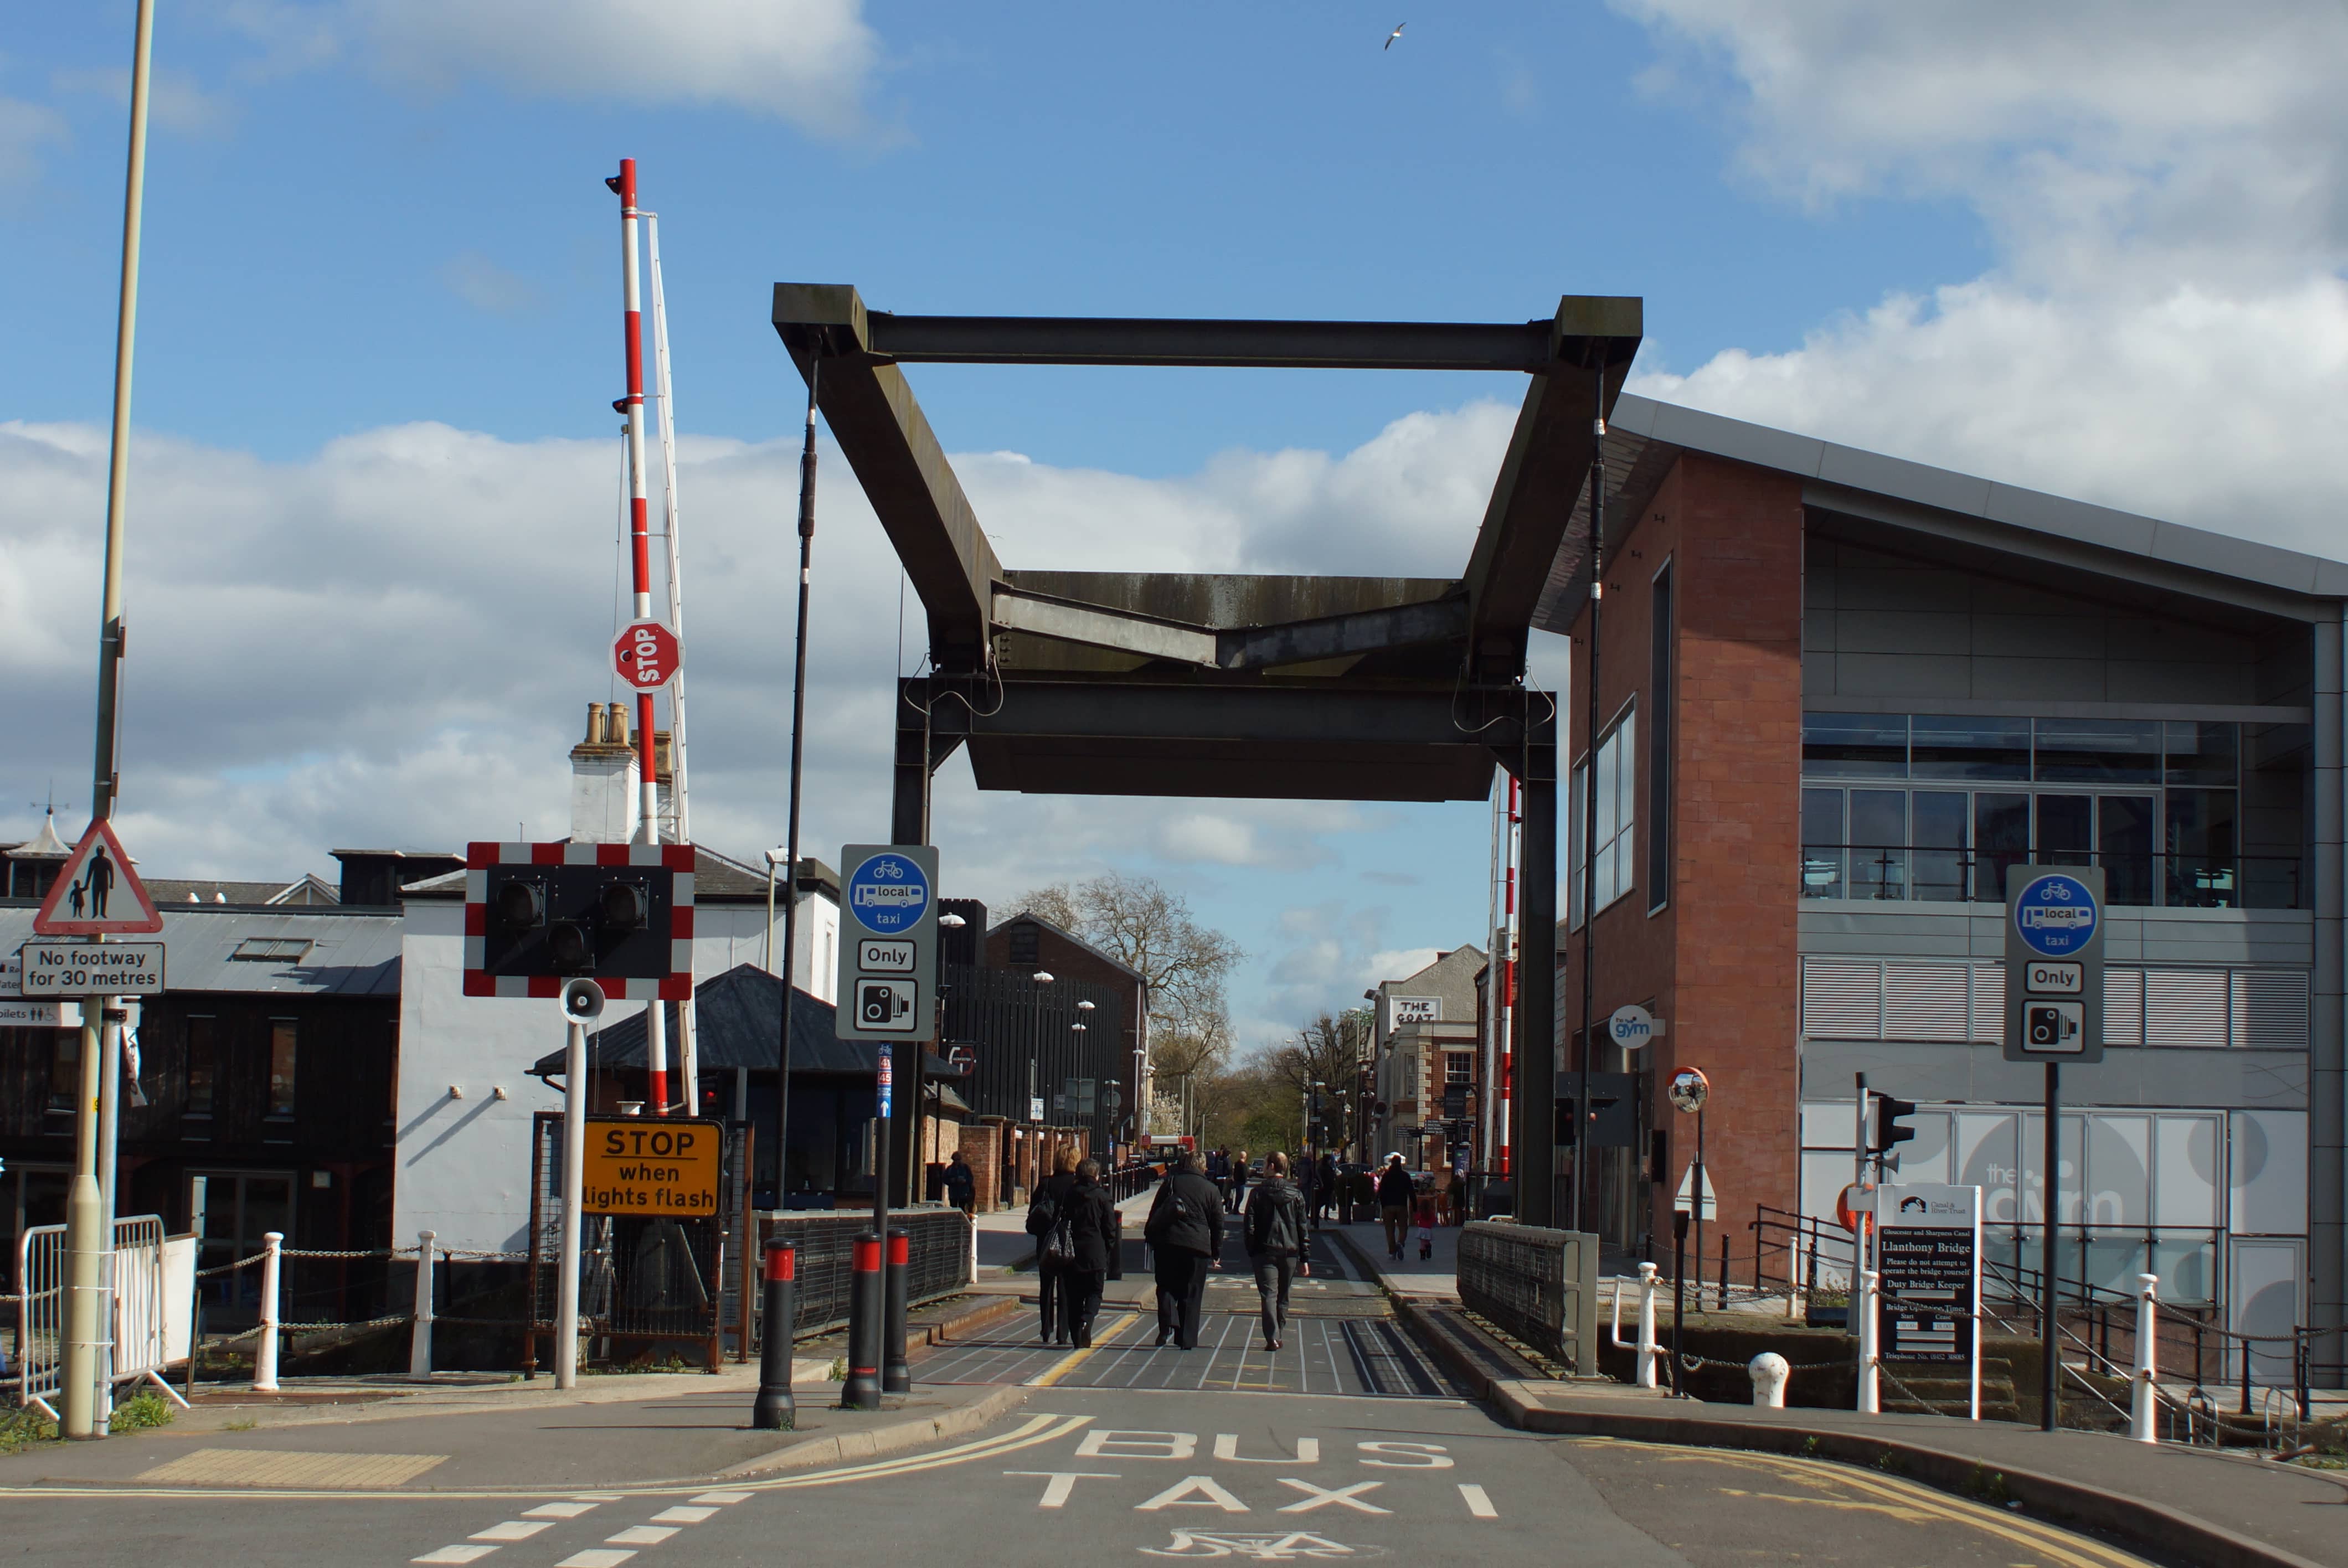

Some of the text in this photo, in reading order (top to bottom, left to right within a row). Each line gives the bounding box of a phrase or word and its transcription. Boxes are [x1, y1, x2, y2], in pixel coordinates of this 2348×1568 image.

[635, 629, 659, 682] STOP
[878, 886, 909, 896] local
[877, 914, 900, 924] taxi
[2045, 908, 2076, 918] local
[2045, 935, 2069, 946] taxi
[39, 950, 146, 967] No footway
[868, 947, 907, 965] Only
[29, 970, 156, 986] for 30 metres
[2034, 969, 2074, 986] Only
[1400, 1002, 1429, 1012] THE
[1397, 1013, 1434, 1022] GOAT
[1615, 1023, 1650, 1038] gym
[879, 1073, 891, 1082] 45
[606, 1129, 695, 1156] STOP
[620, 1163, 679, 1182] when
[1986, 1163, 2017, 1184] the
[583, 1186, 714, 1209] lights flash
[1882, 1241, 1971, 1254] Llanthony Bridge
[1887, 1280, 1965, 1290] Duty Bridge Keeper
[1886, 1303, 1908, 1312] Bridge
[1944, 1304, 1965, 1313] Times
[1884, 1352, 1916, 1360] Telephone
[1074, 1429, 1455, 1468] BUS
[1002, 1471, 1499, 1518] TAXI
